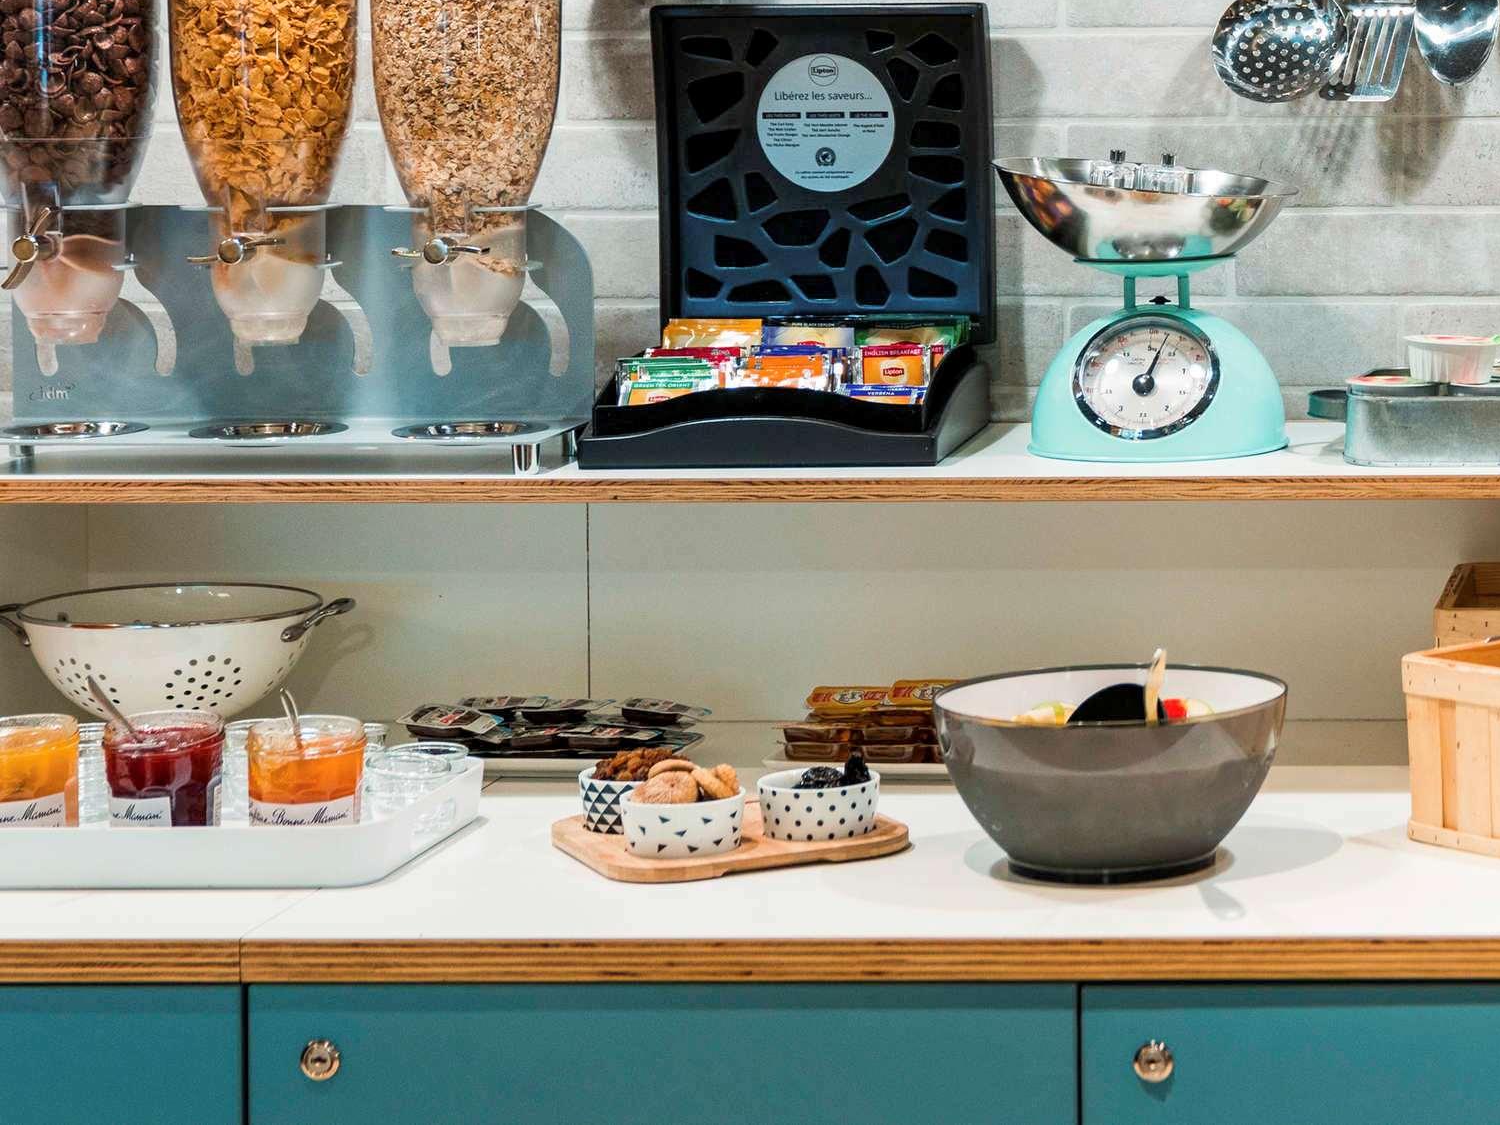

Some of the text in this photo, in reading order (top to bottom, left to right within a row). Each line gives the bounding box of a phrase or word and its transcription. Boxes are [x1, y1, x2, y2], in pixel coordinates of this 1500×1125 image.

[775, 91, 809, 100] Libérez
[812, 91, 825, 100] les
[884, 368, 903, 376] Lipton
